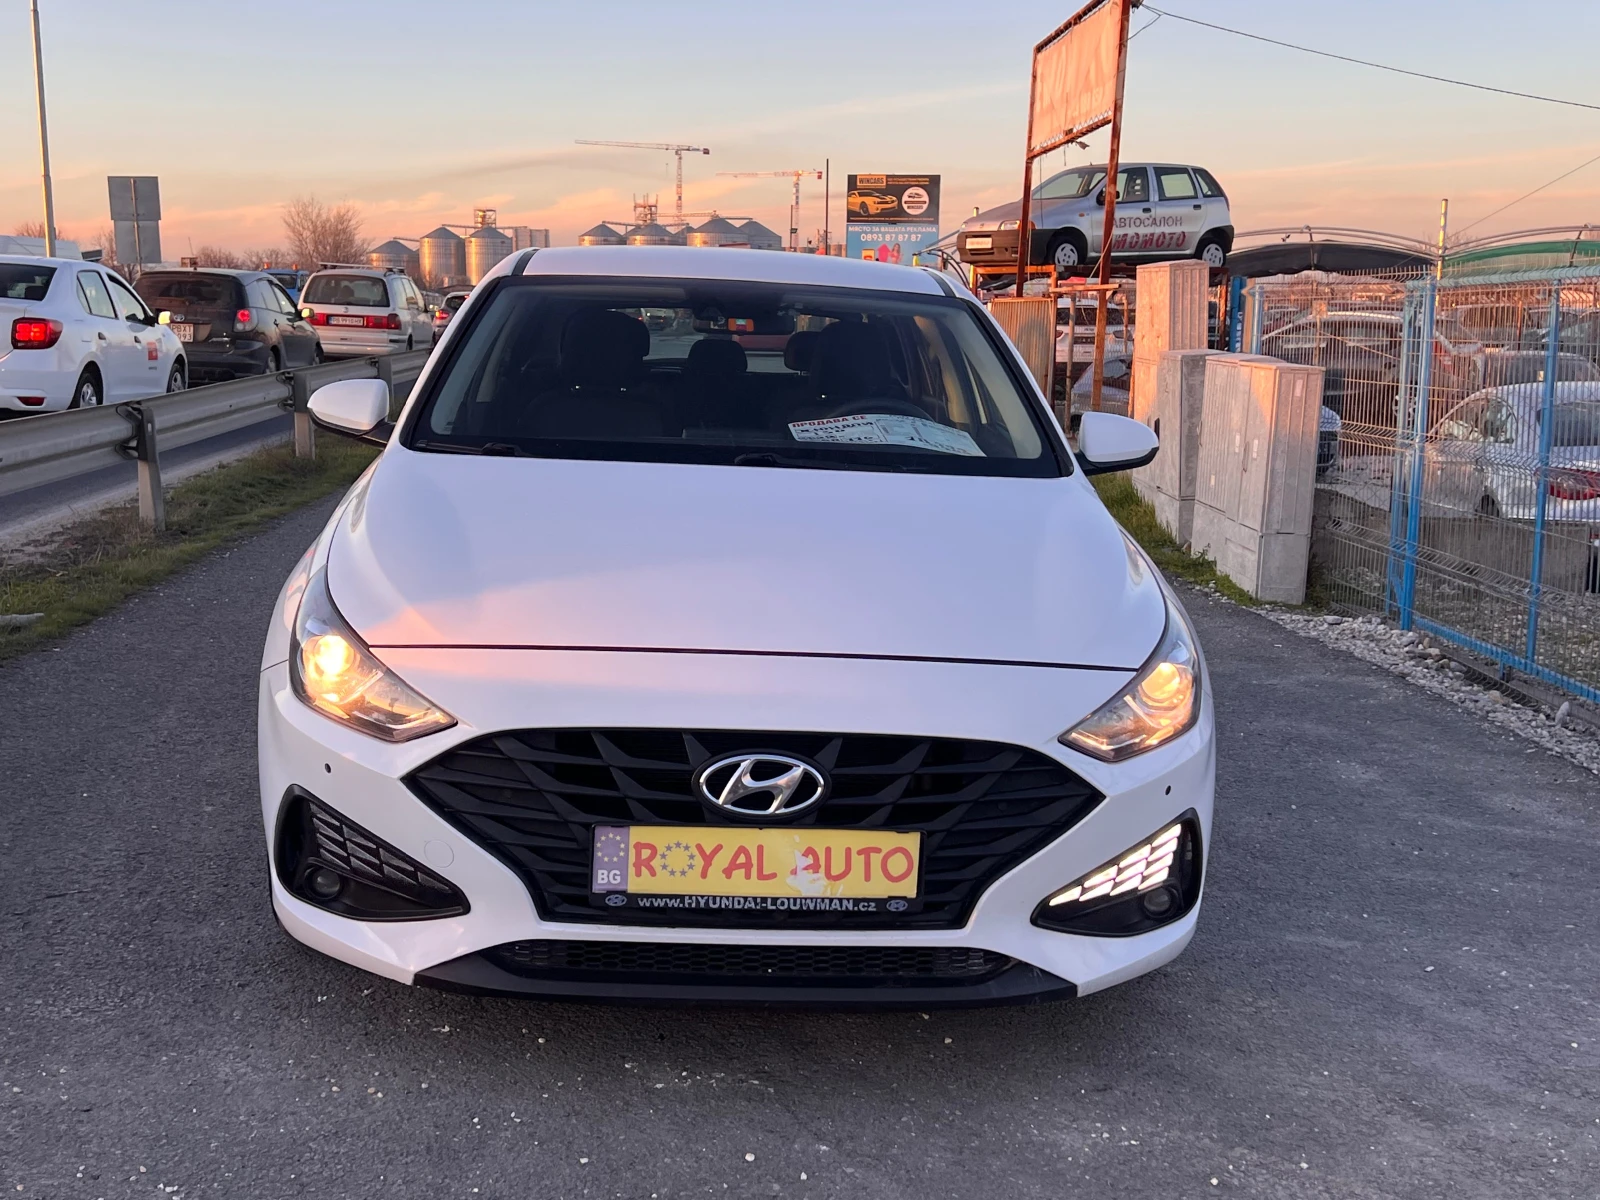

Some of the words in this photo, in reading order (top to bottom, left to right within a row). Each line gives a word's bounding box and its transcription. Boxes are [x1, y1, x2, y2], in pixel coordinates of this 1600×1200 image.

[858, 177, 884, 185] WINCARS
[1113, 216, 1183, 229] АВТОСАЛОН
[792, 417, 849, 428] ПРОДАВА
[789, 845, 914, 883] AUTO
[597, 869, 621, 884] BG
